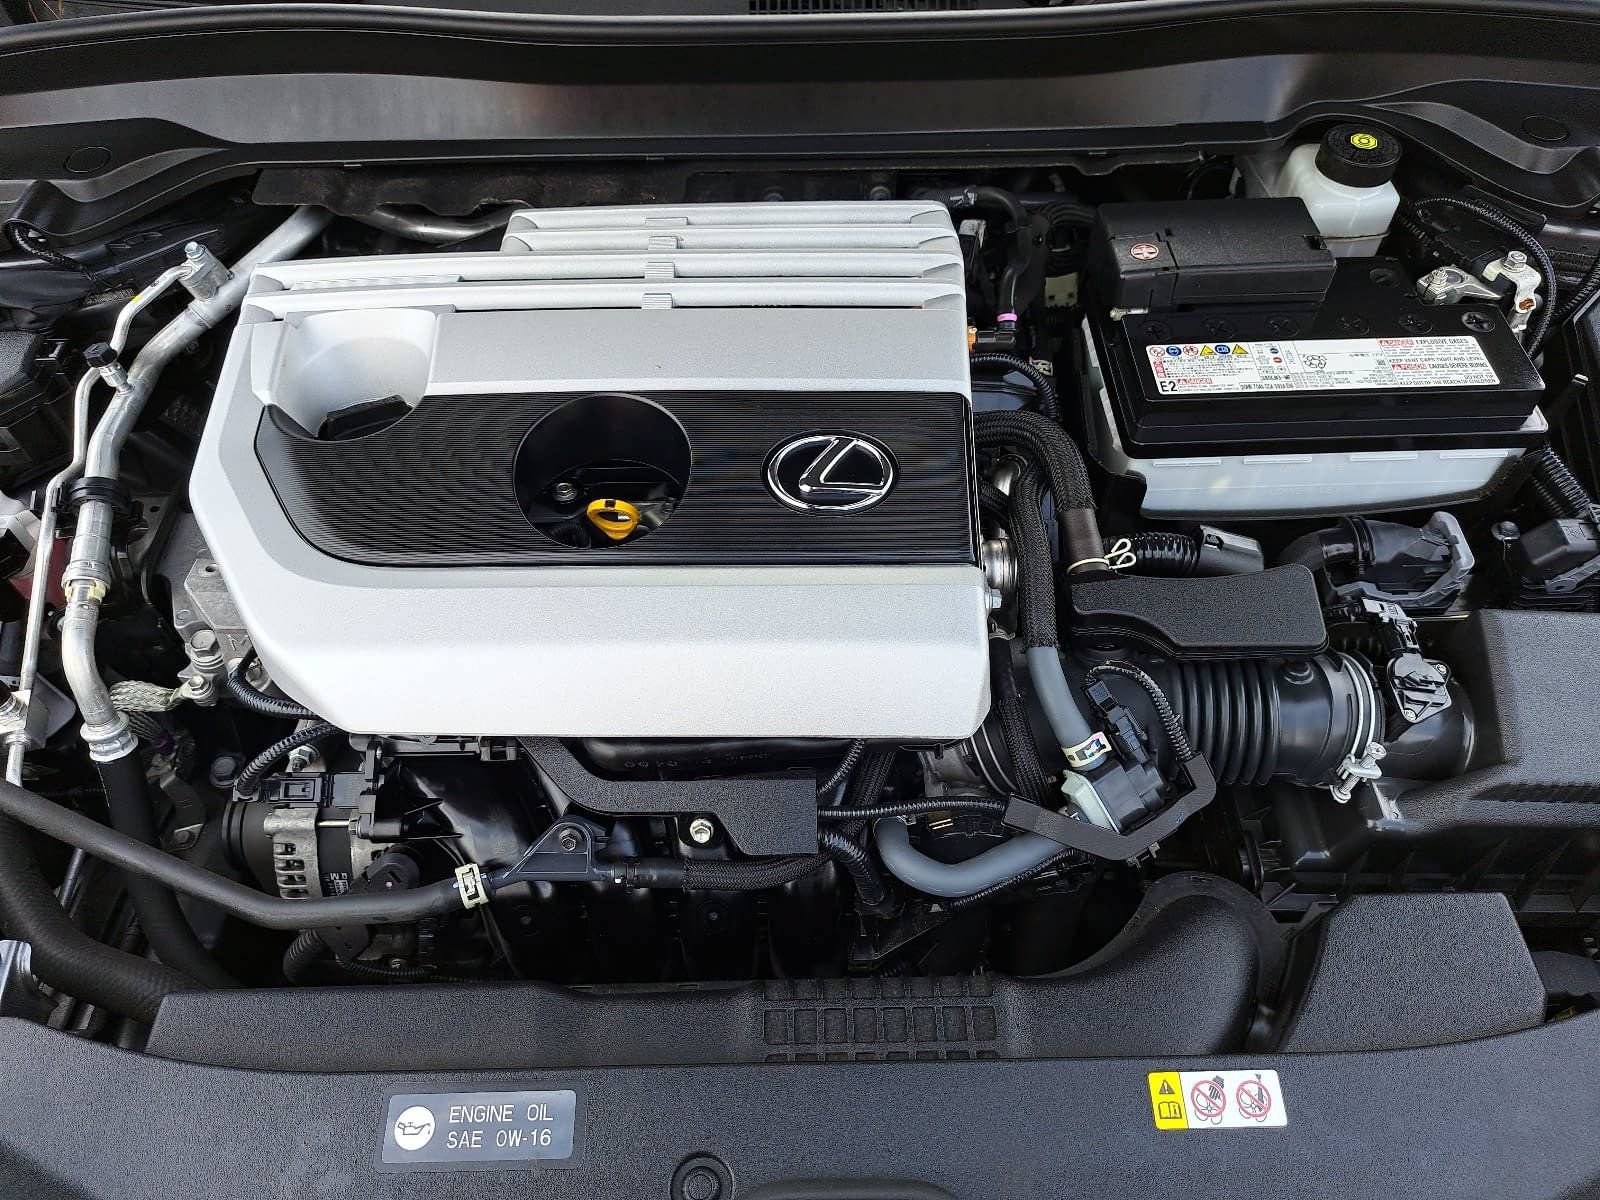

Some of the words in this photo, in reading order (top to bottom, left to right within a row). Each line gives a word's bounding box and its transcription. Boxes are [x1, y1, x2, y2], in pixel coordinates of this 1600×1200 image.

[1159, 380, 1178, 393] E2
[449, 1104, 515, 1123] ENGINE
[527, 1103, 554, 1121] OIL
[446, 1130, 484, 1149] SAE
[496, 1128, 552, 1147] 0W-16
